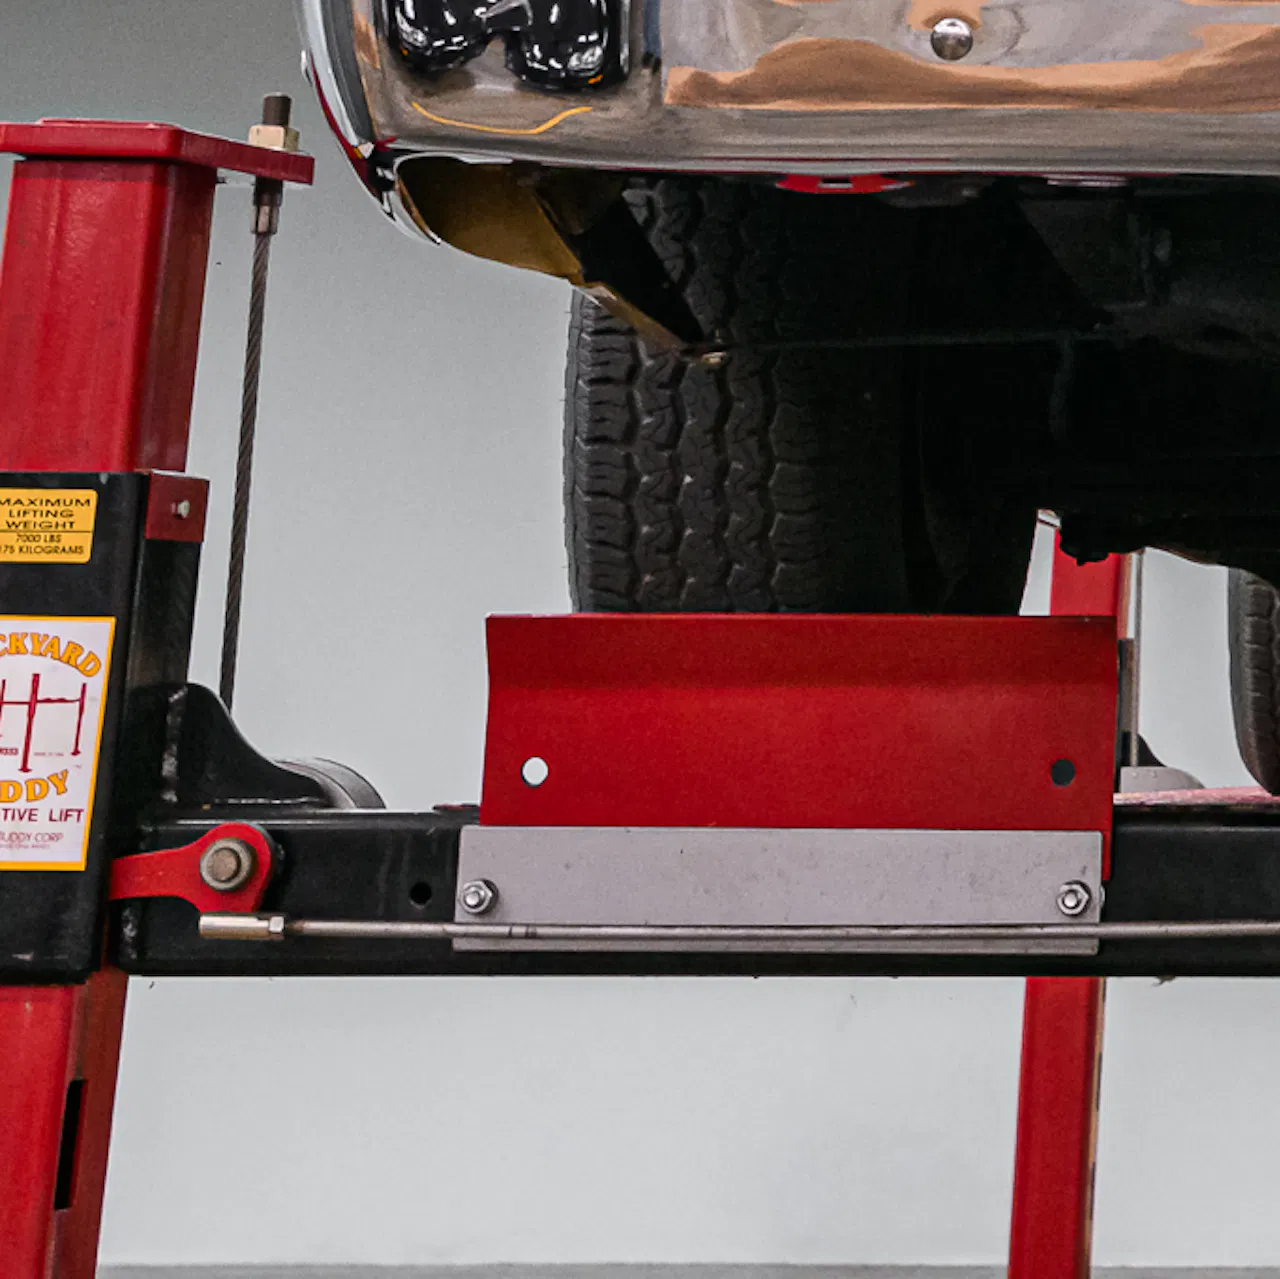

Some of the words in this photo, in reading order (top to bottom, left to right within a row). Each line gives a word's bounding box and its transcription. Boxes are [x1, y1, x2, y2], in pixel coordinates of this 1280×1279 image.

[0, 498, 90, 507] MAXIMUM
[9, 509, 74, 518] LIFTING
[6, 521, 75, 529] WEIGHT
[16, 534, 41, 543] 7000
[43, 534, 62, 543] LBS
[18, 545, 84, 555] KILOGRAMS
[2, 808, 39, 822] TIVE
[48, 808, 85, 823] LIFT
